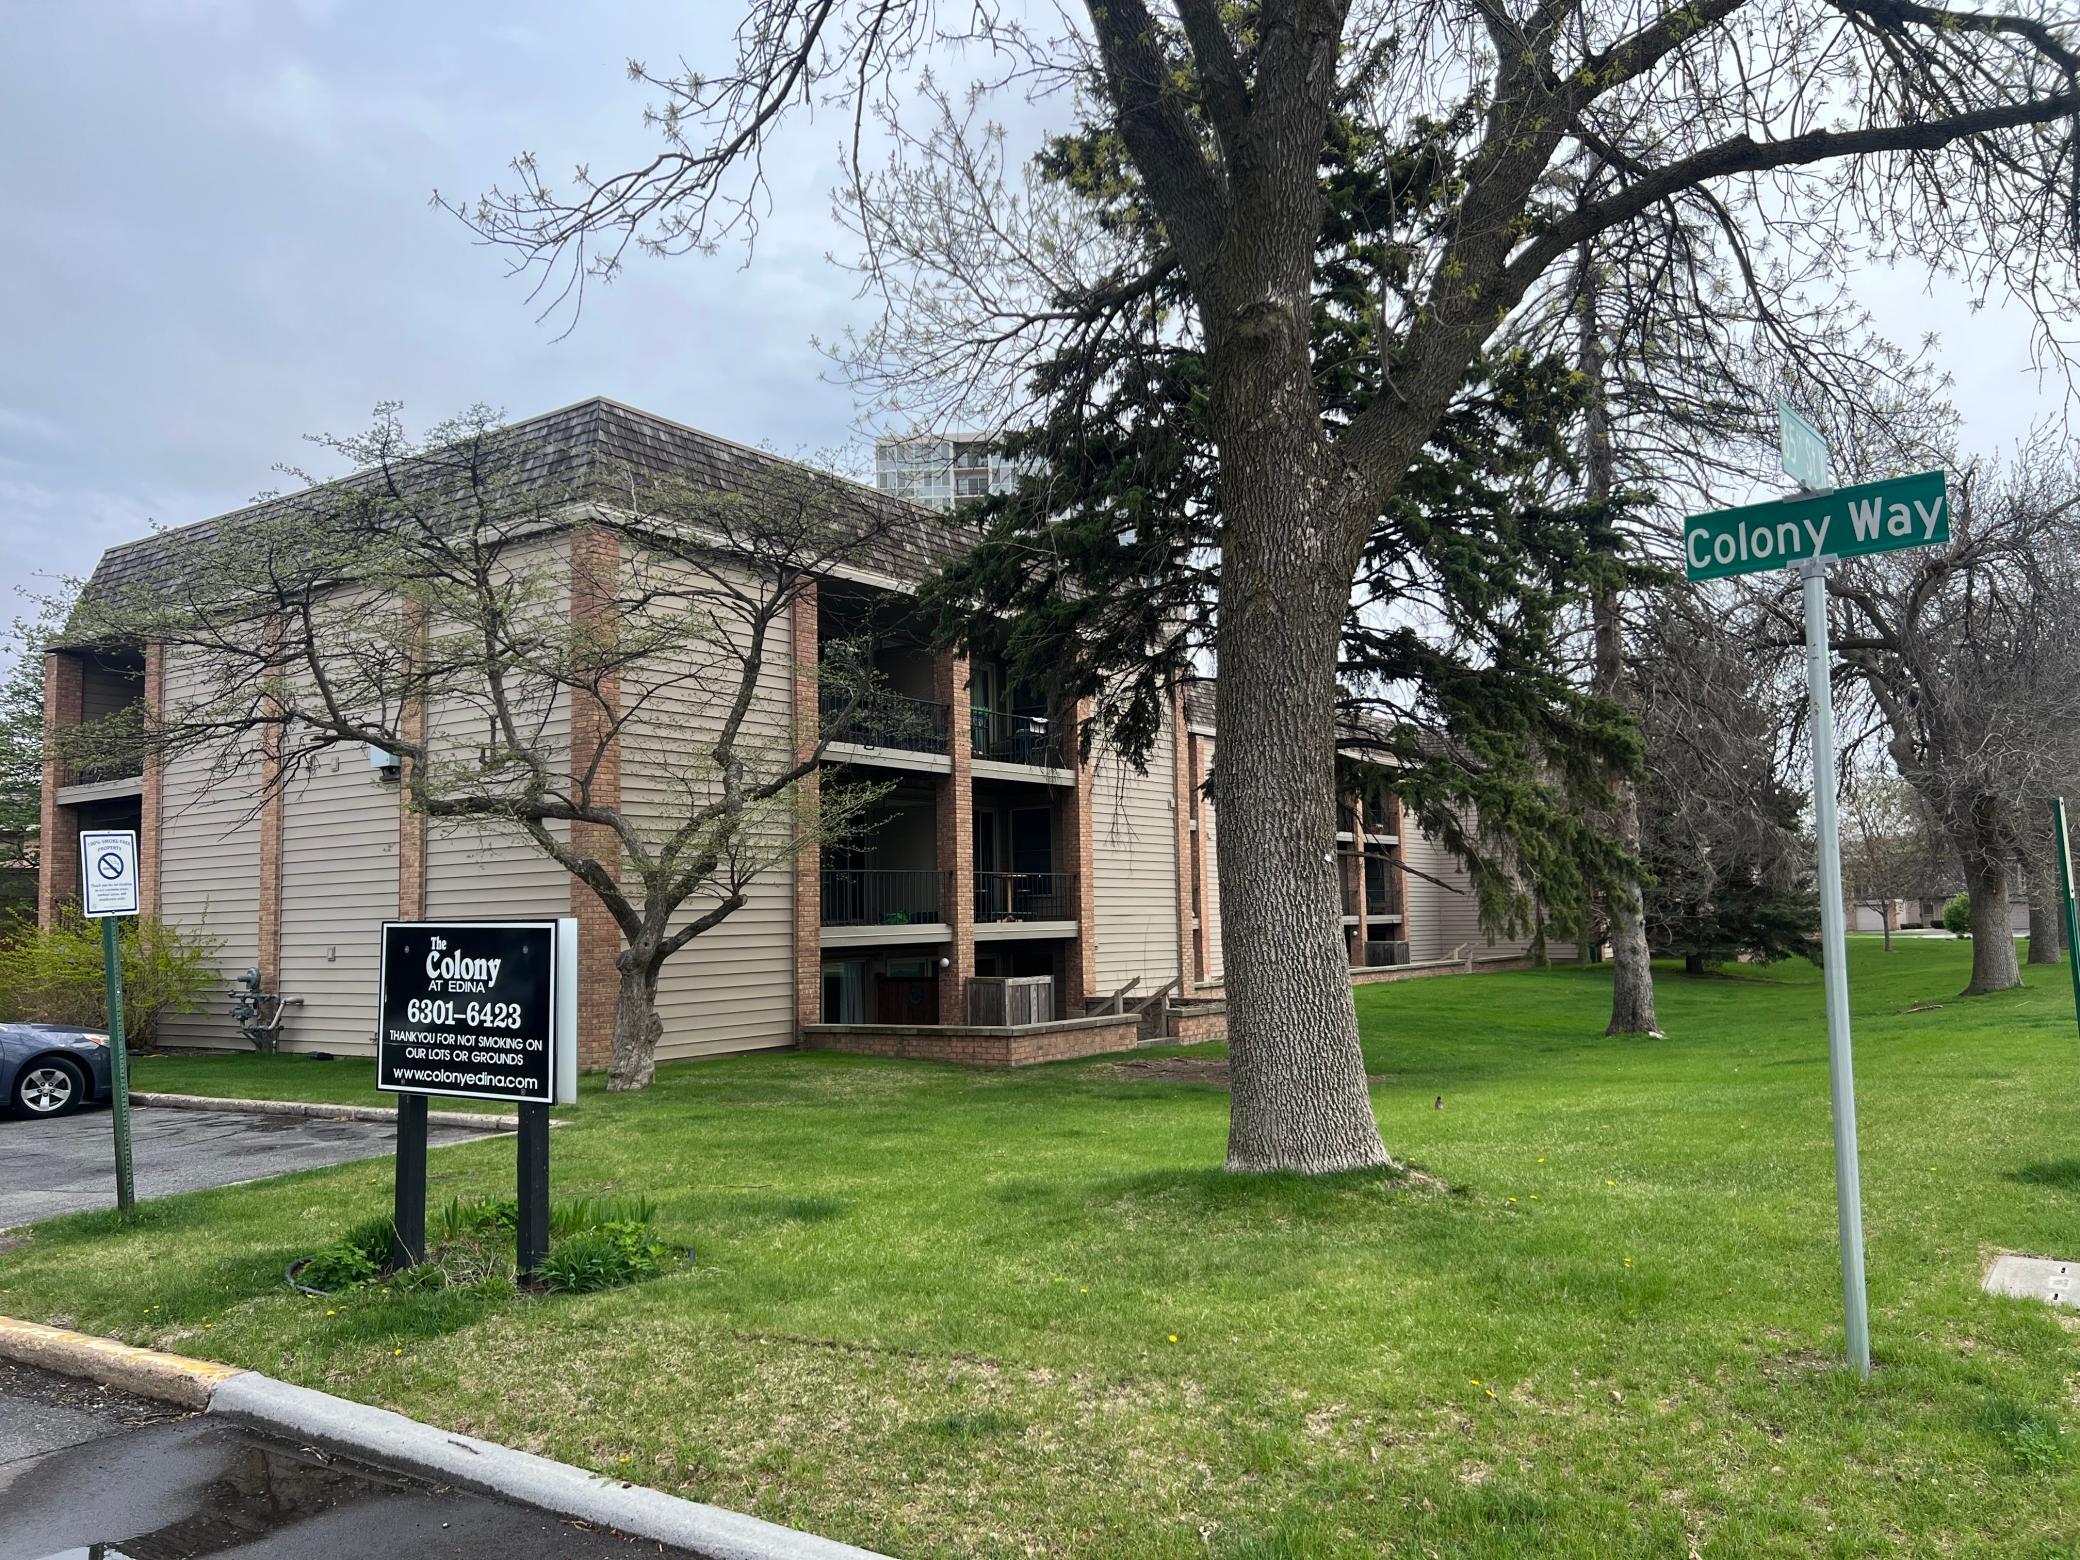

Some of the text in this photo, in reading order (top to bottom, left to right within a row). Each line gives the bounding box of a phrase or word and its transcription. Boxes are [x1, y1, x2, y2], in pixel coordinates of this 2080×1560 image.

[1687, 496, 1944, 569] Colony Way
[430, 936, 447, 950] The
[426, 949, 501, 987] Colony
[428, 980, 485, 993] AT EDINA
[407, 999, 521, 1029] 6301-6423
[437, 1033, 455, 1046] FOR
[457, 1035, 476, 1047] NOT
[478, 1036, 523, 1050] SMOKING
[525, 1039, 542, 1051] ON
[405, 1047, 523, 1065] OUR LOTS OR GROUNDS
[393, 1067, 538, 1089] www.colonyedina.com
